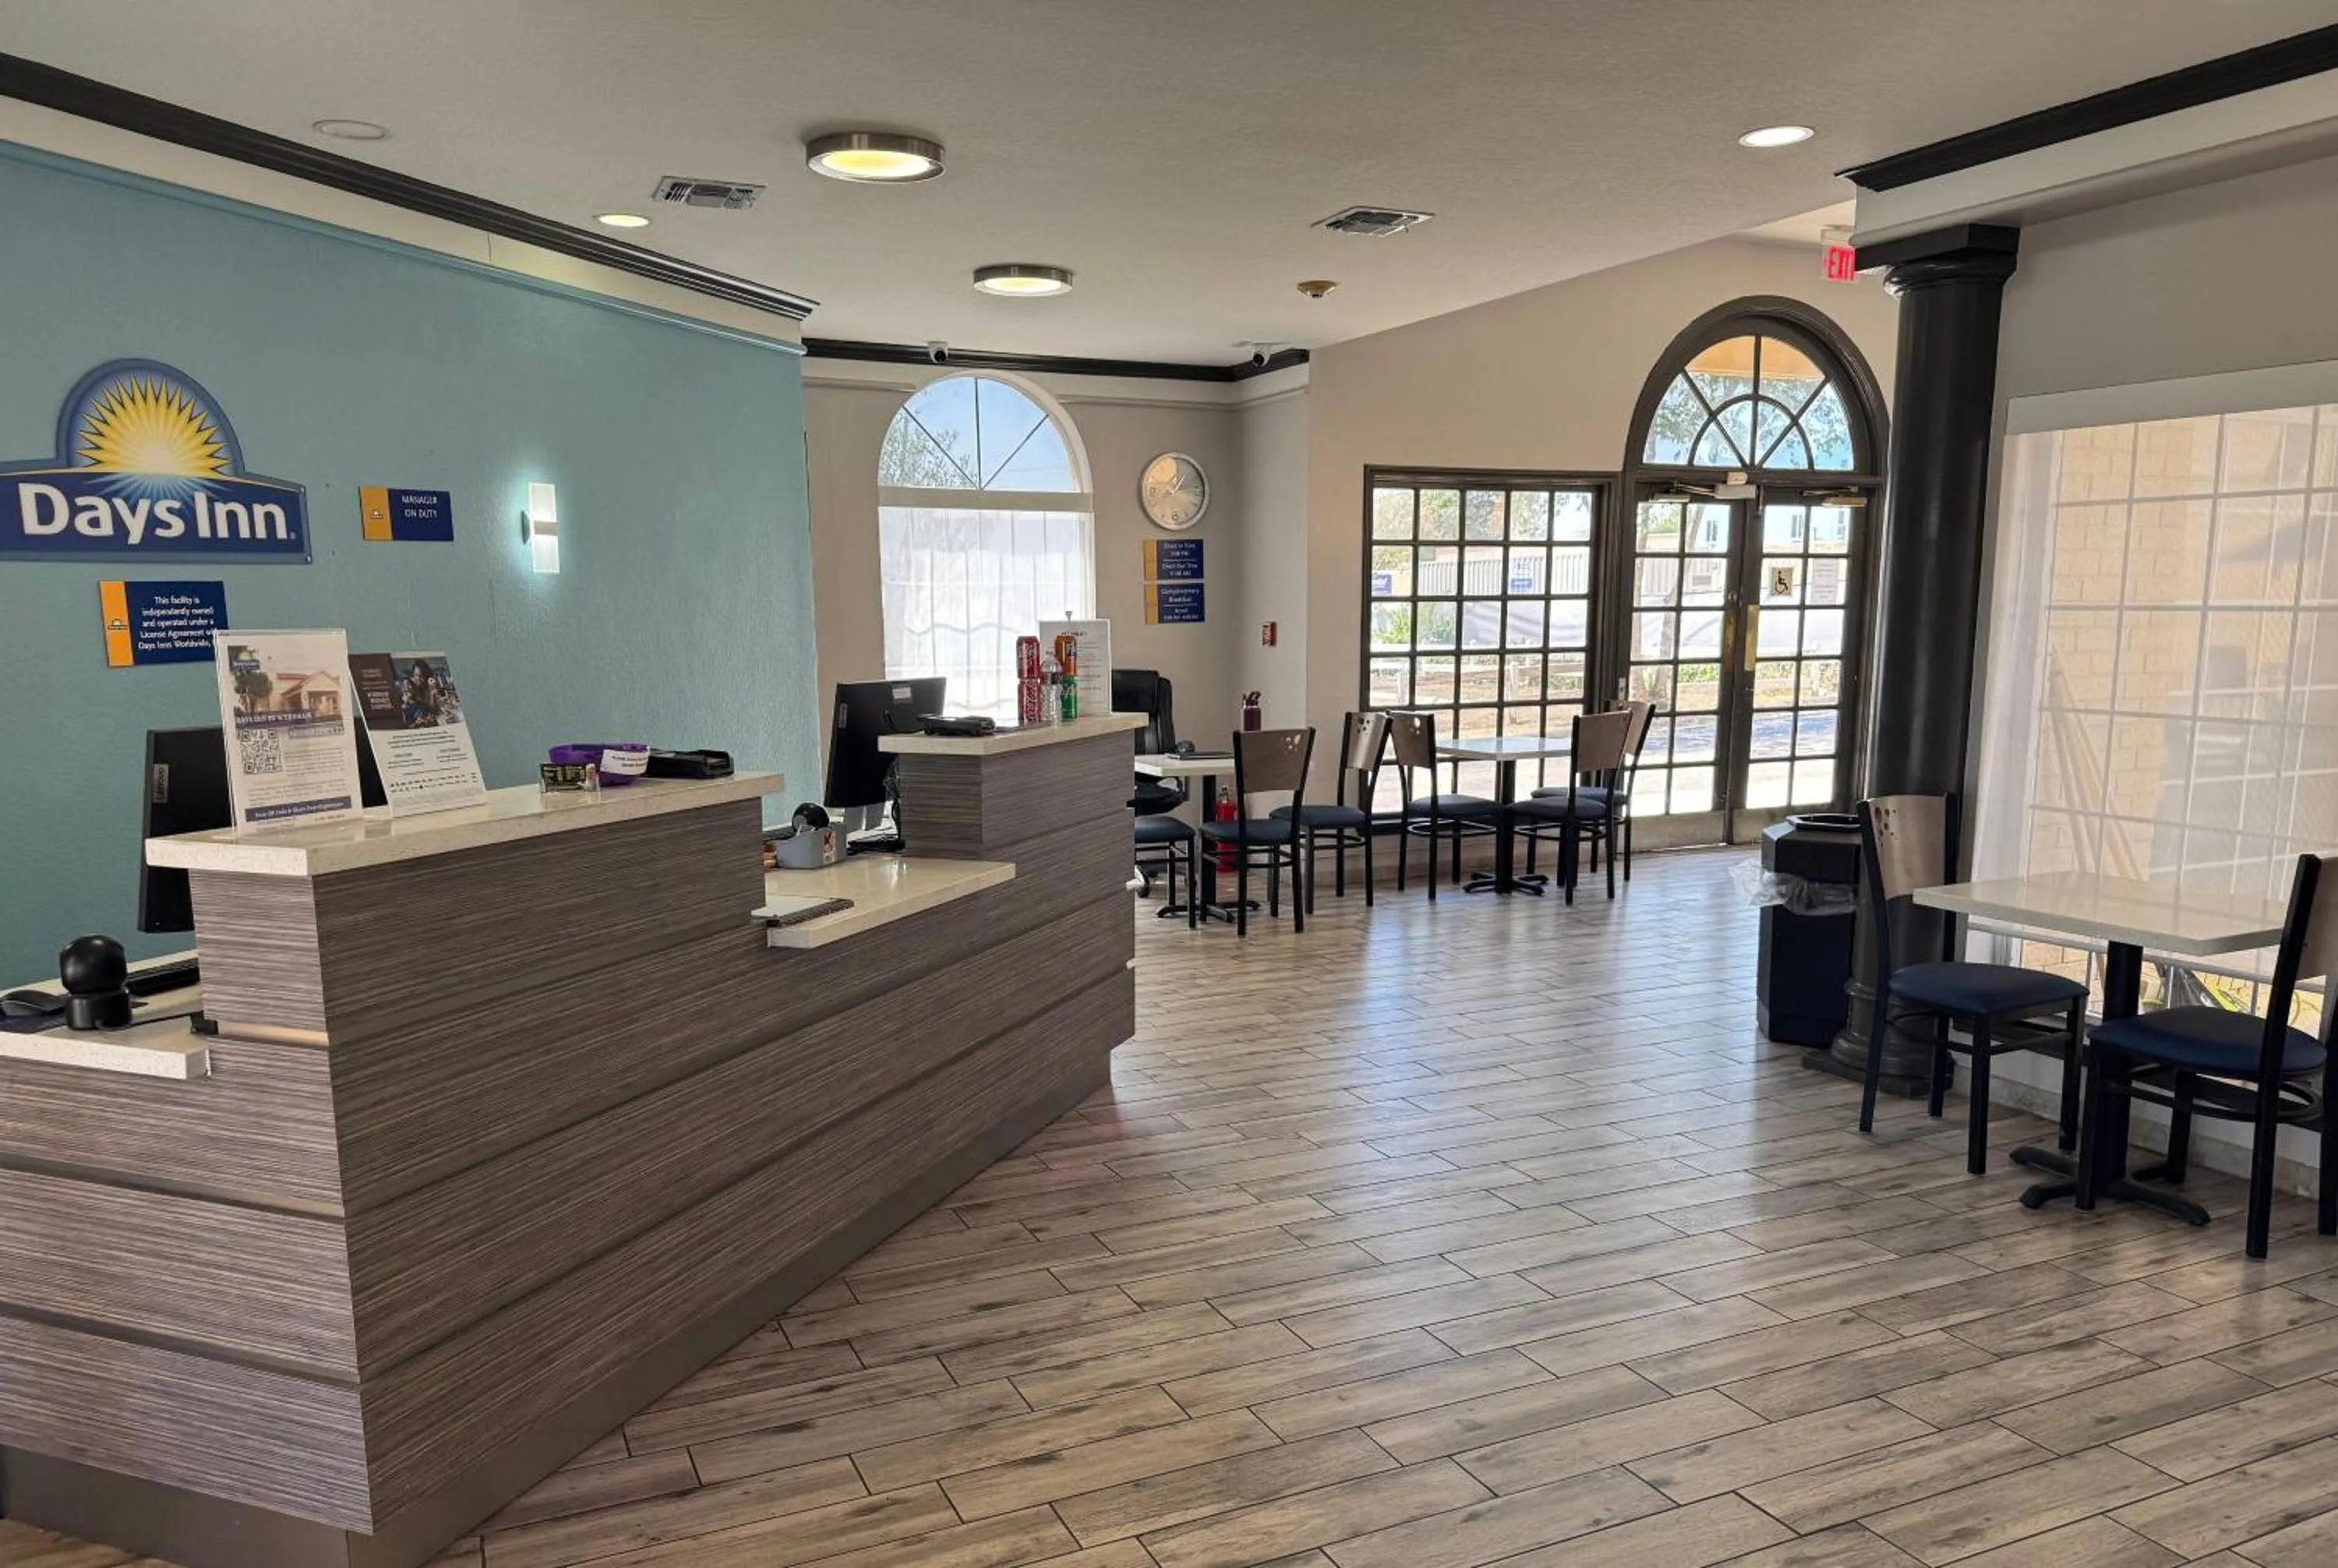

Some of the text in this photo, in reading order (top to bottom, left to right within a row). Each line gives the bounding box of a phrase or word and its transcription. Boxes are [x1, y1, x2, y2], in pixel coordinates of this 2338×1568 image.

[1828, 246, 1855, 281] EXIT
[401, 495, 437, 504] MANAGER
[18, 482, 287, 545] Days Inn
[404, 509, 437, 518] ON DUTY
[154, 596, 170, 605] This
[171, 595, 193, 606] facility
[142, 606, 214, 617] independently owned
[142, 619, 155, 627] and
[157, 618, 187, 629] operated
[188, 616, 208, 627] under
[140, 630, 166, 639] License
[168, 629, 205, 639] Agreement
[138, 641, 156, 652] Days
[157, 641, 172, 650] Inns
